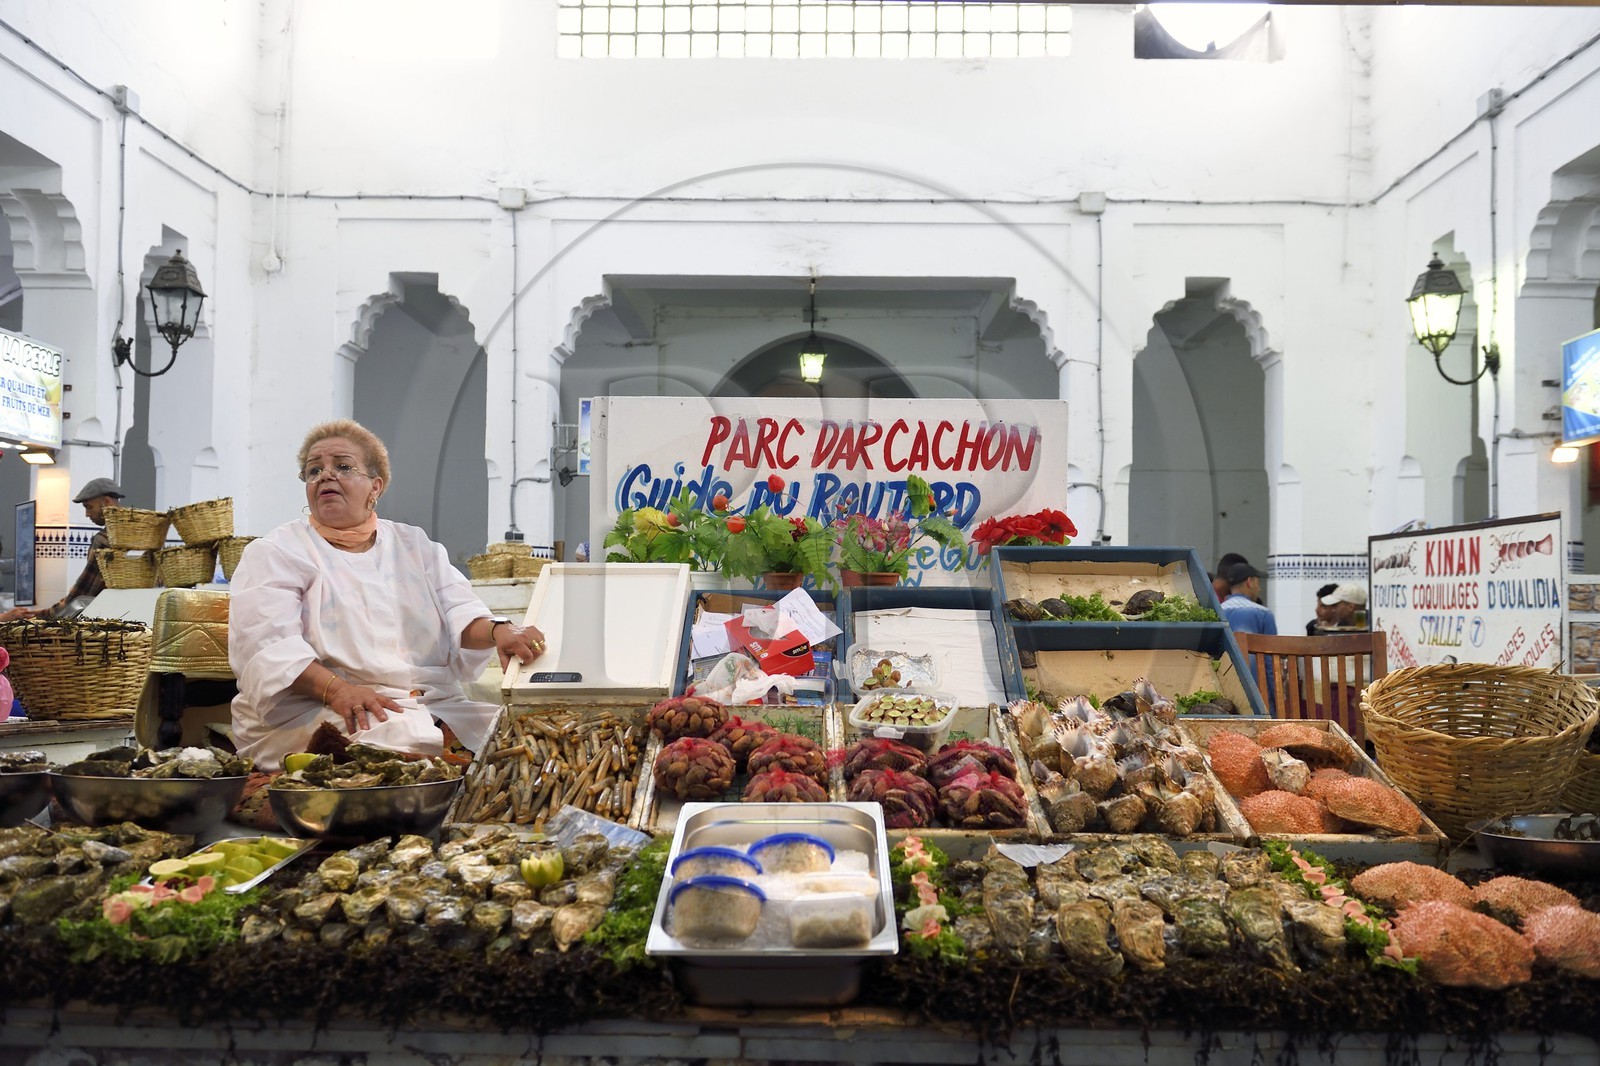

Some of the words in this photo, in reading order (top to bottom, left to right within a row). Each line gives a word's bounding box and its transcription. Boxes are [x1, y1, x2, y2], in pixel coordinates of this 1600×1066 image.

[2, 336, 20, 366] LA
[22, 343, 62, 377] PERLE
[2, 395, 26, 412] FRUITS
[27, 402, 36, 414] DE
[37, 404, 51, 418] MER
[37, 387, 46, 399] ET
[702, 415, 806, 471] PARC
[1425, 536, 1480, 577] KINAN
[1373, 584, 1407, 609] TOUTES
[1412, 582, 1479, 610] COQUILLAGES
[1487, 578, 1560, 609] D'OUALIDIA
[1418, 615, 1465, 647] STALLE
